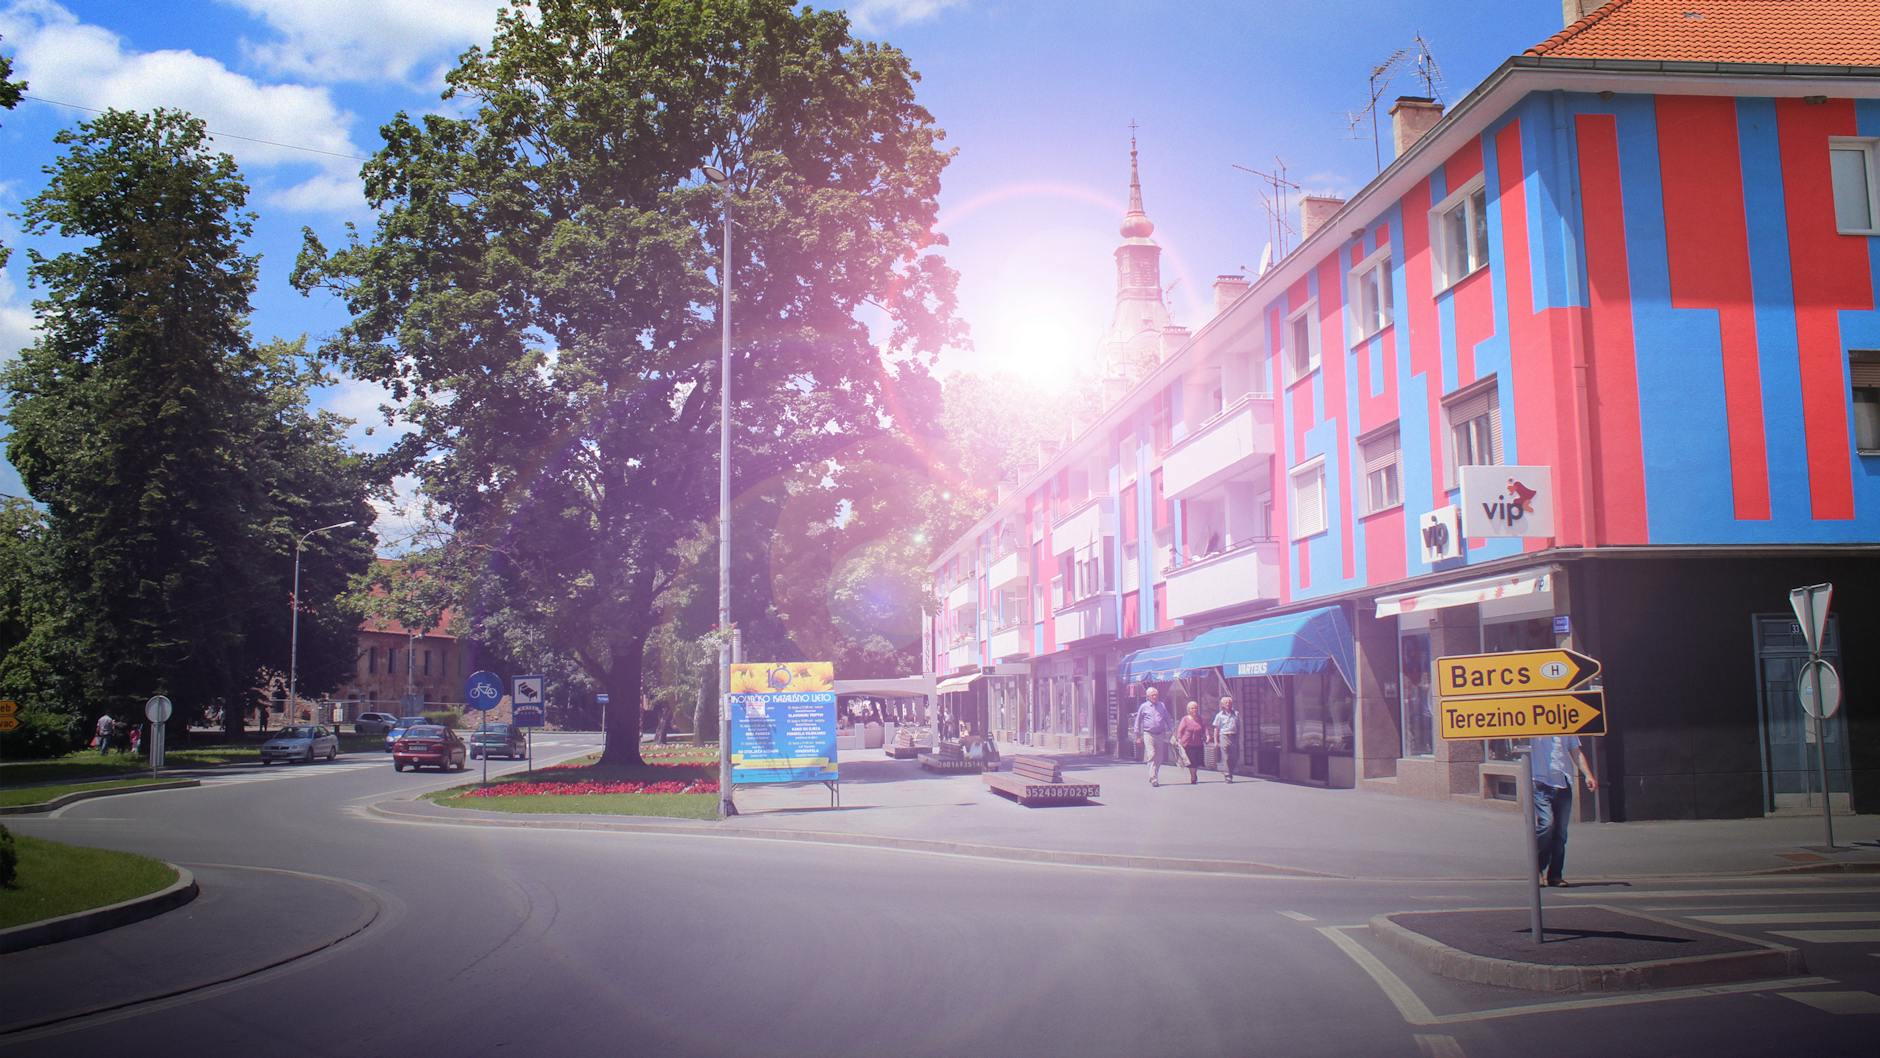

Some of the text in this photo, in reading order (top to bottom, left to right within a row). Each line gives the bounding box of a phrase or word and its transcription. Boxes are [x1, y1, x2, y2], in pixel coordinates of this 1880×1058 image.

[1482, 494, 1524, 527] vip
[1422, 515, 1449, 554] vip
[1238, 662, 1268, 675] VARTEKS
[1451, 664, 1560, 688] Barcs H
[1446, 703, 1580, 730] Terezino Polje
